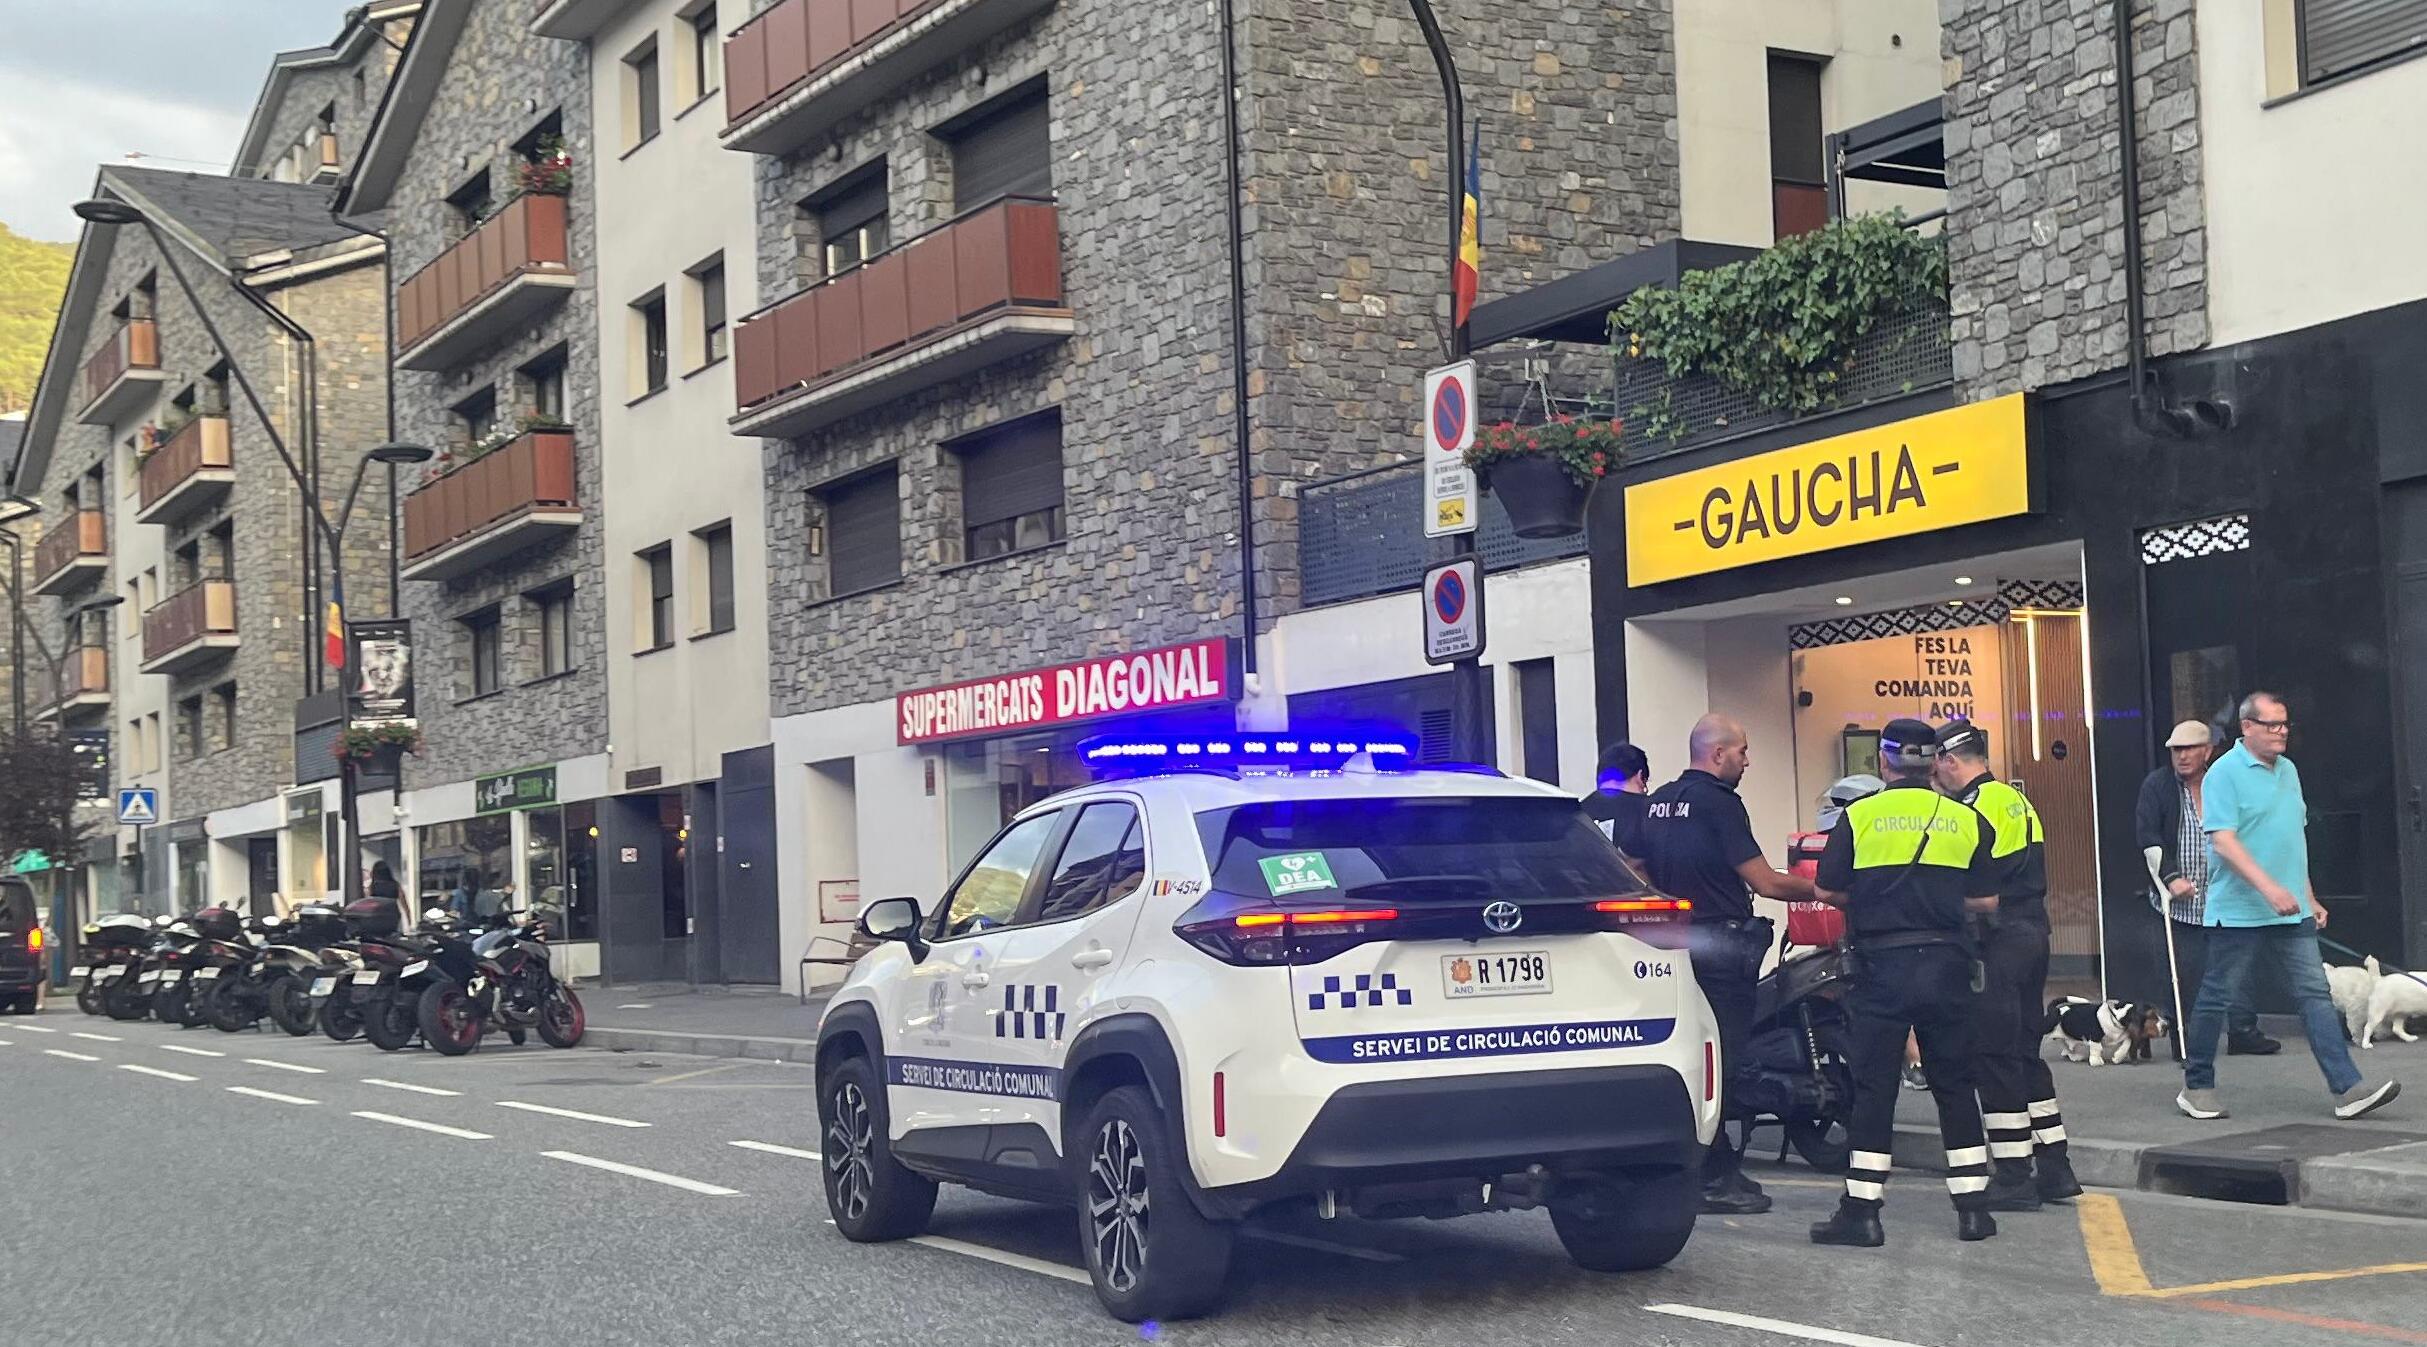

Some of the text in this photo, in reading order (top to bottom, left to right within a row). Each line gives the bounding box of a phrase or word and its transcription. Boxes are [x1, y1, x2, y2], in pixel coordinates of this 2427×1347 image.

[1916, 637, 1971, 654] FES LA
[1925, 658, 1972, 675] TEVA
[902, 645, 1218, 739] SUPERMERCATS DIAGONAL
[1875, 680, 1973, 697] COMANDA
[1278, 869, 1322, 885] DEA
[1478, 957, 1544, 984] R 1798
[1649, 962, 1672, 978] 164
[1454, 985, 1474, 994] AND
[1352, 1026, 1643, 1058] SERVEI DE CIRCULACIÓ COMUNAL
[902, 1063, 1053, 1098] SERVEI DE CIRCULACIÓ COMUNAL
